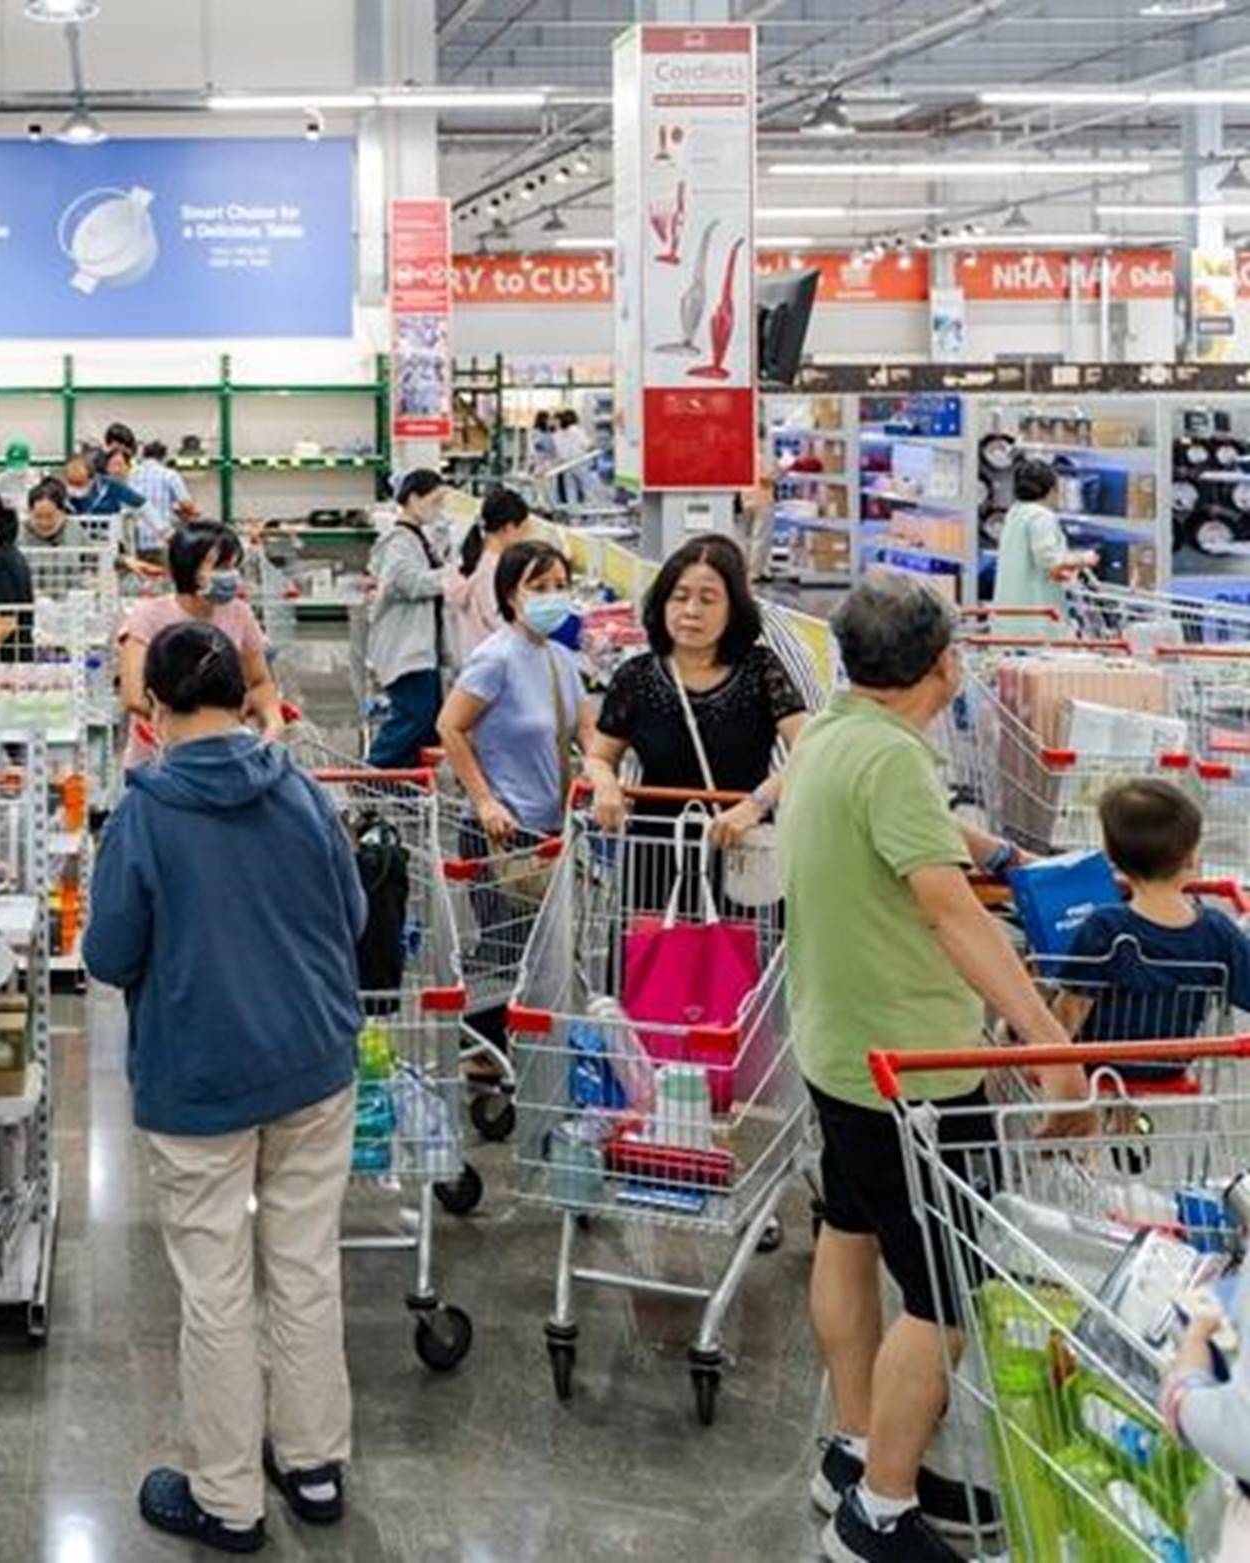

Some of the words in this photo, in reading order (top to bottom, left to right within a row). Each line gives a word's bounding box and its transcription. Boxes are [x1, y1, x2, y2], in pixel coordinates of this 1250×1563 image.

[655, 61, 745, 81] Cordless
[181, 204, 223, 220] Smart
[226, 204, 276, 220] Choice
[280, 203, 300, 220] for
[195, 224, 261, 239] Delicious
[493, 268, 525, 294] to
[992, 257, 1054, 290] NHÀ
